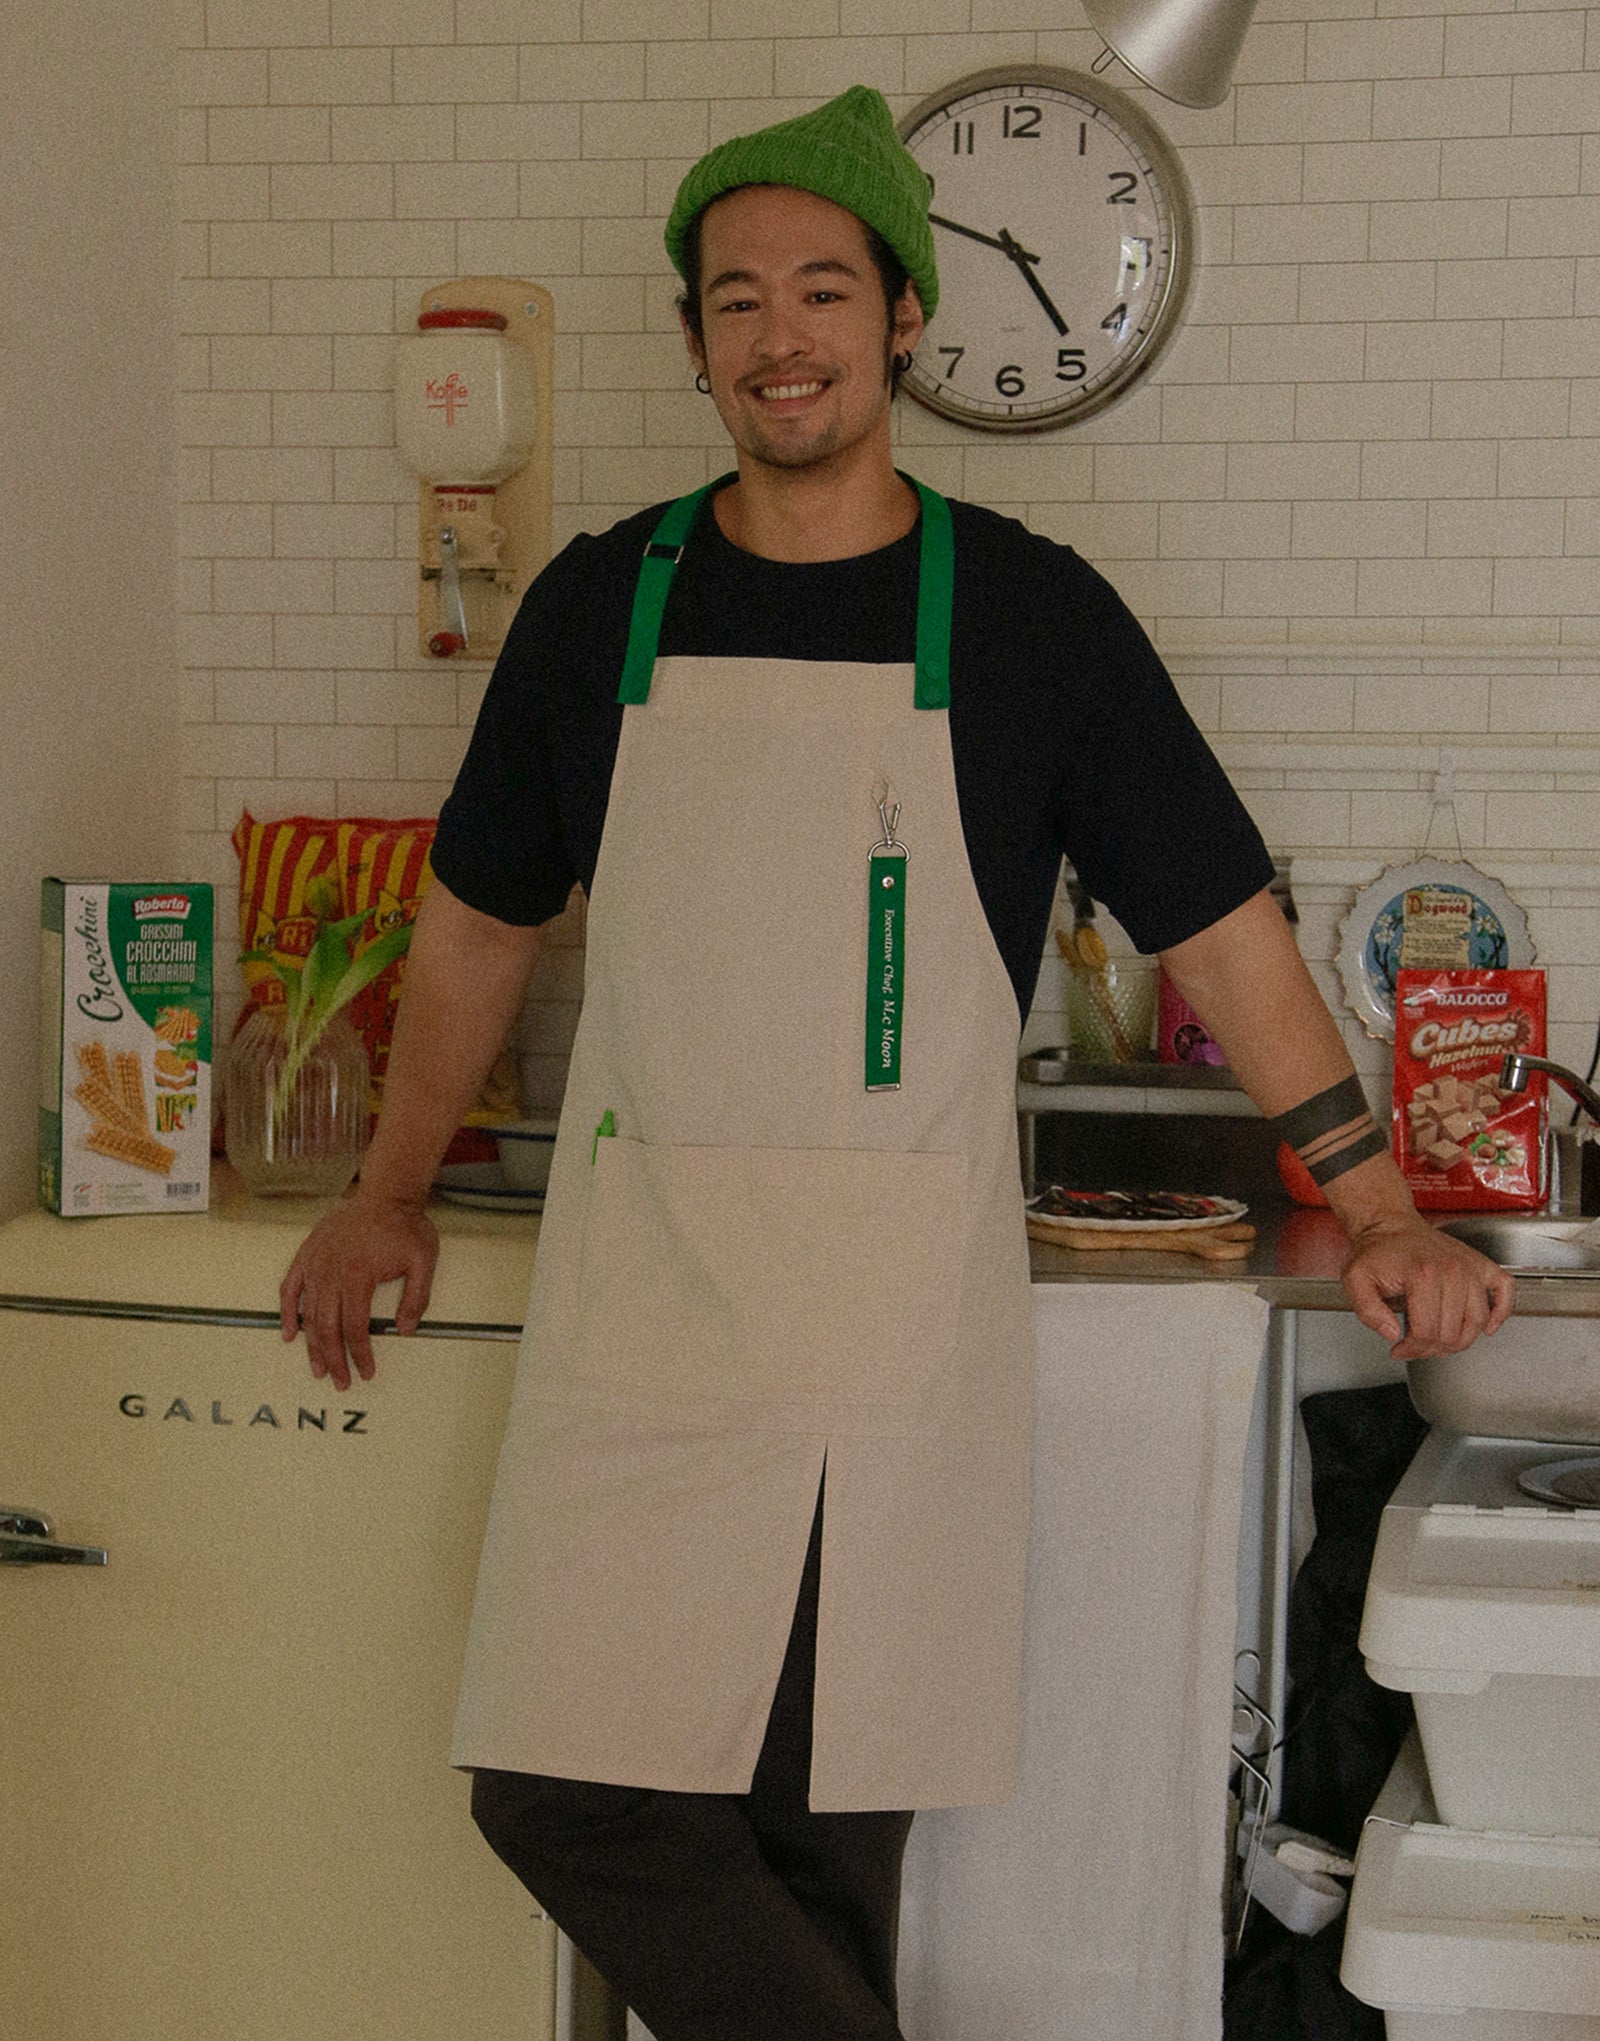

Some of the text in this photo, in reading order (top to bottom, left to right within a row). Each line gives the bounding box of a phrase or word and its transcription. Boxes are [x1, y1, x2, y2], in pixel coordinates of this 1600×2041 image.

[952, 121, 975, 155] 11
[1002, 104, 1043, 139] 12
[1077, 121, 1087, 156] 1
[1107, 171, 1138, 205] 2
[1126, 236, 1153, 270] 3
[1101, 302, 1128, 332] 4
[939, 347, 965, 379] 7
[1055, 349, 1087, 382] 5
[995, 365, 1026, 398] 6
[134, 897, 185, 914] Roberto
[1407, 894, 1468, 916] Dogwood
[140, 924, 184, 940] GRISSINI
[884, 908, 895, 962] Executive
[76, 896, 124, 1023] Crocchini
[126, 940, 197, 962] CROCCHINI
[127, 962, 195, 983] AL ROSMARINO
[1436, 993, 1508, 1006] BALOCCO
[881, 1028, 895, 1068] Moon
[1412, 1019, 1518, 1054] Cubes
[1429, 1044, 1502, 1070] Hazelnut
[119, 1394, 368, 1435] GALANZ
